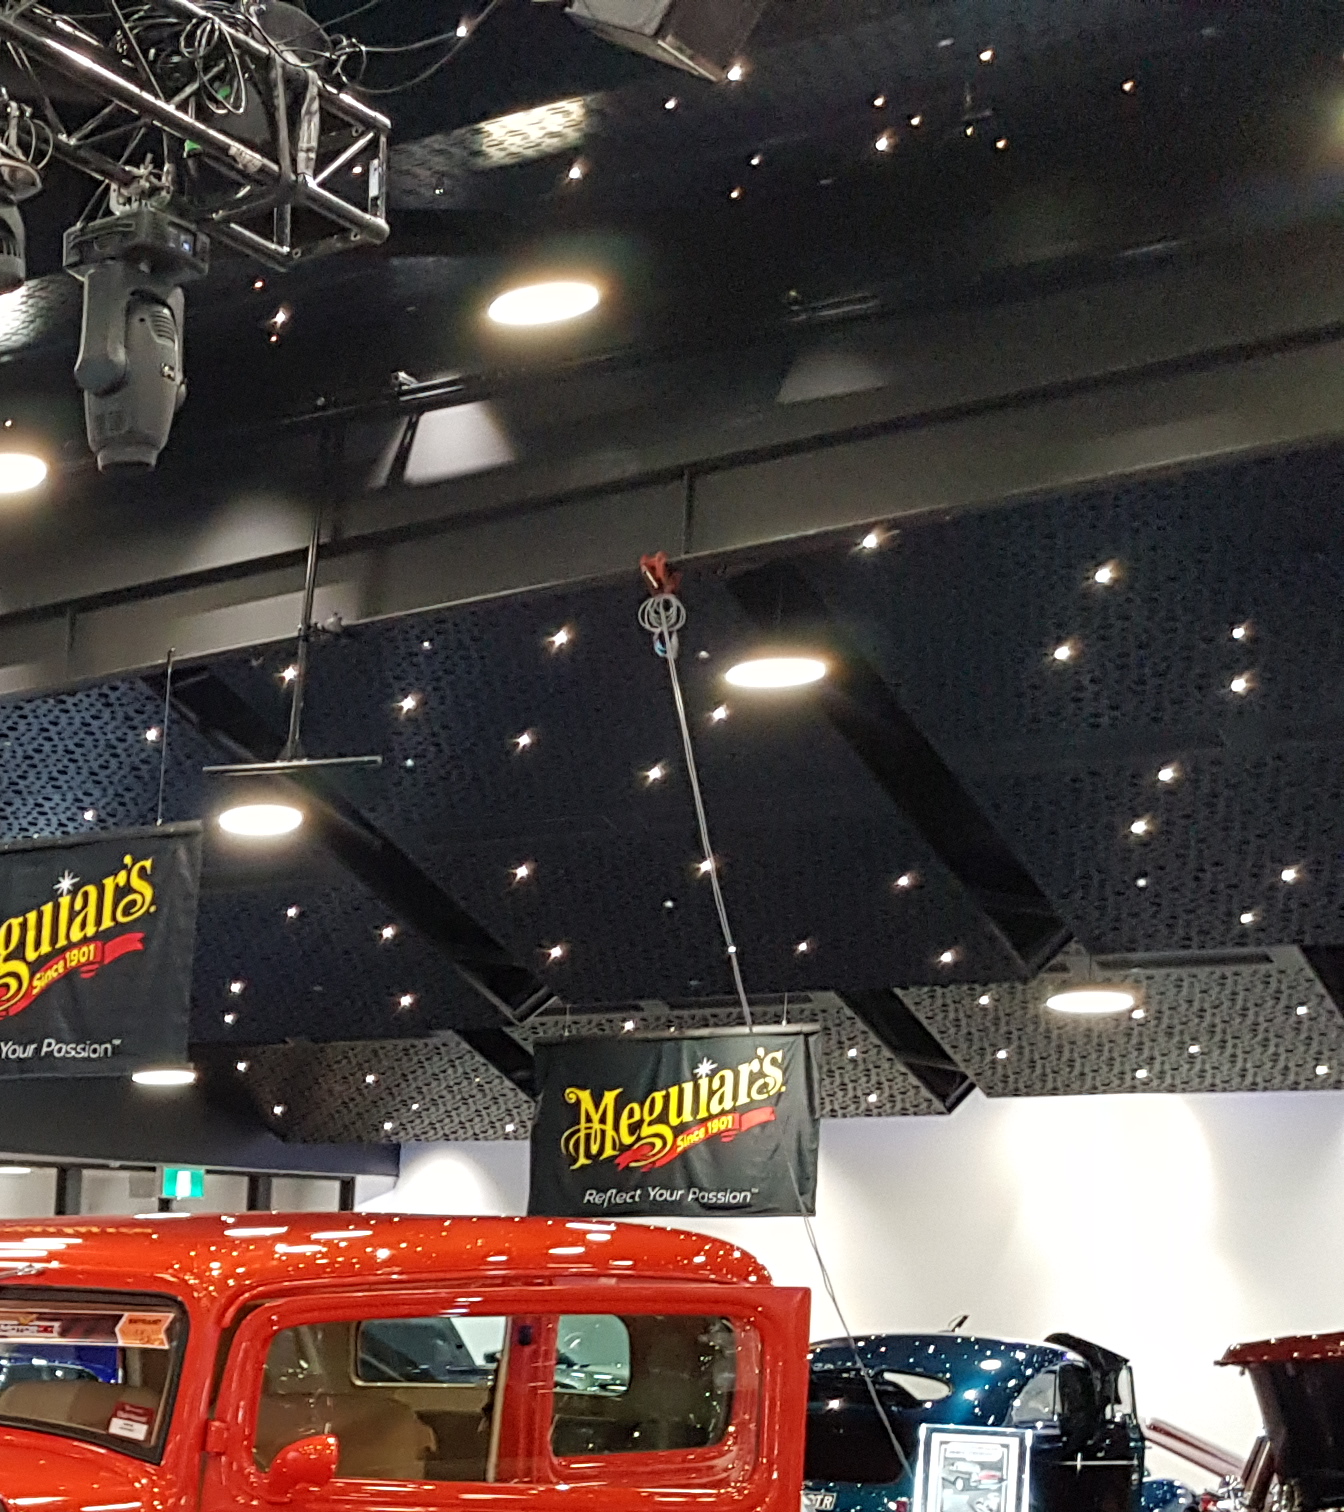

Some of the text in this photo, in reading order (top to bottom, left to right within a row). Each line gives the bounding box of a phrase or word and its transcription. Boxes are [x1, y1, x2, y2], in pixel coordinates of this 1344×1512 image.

[31, 943, 96, 996] Since 1901
[0, 1040, 36, 1060] Your
[561, 1047, 786, 1170] Meguiar's
[675, 1115, 733, 1154] Since 1901
[583, 1187, 641, 1208] Reflect
[648, 1186, 682, 1202] Your
